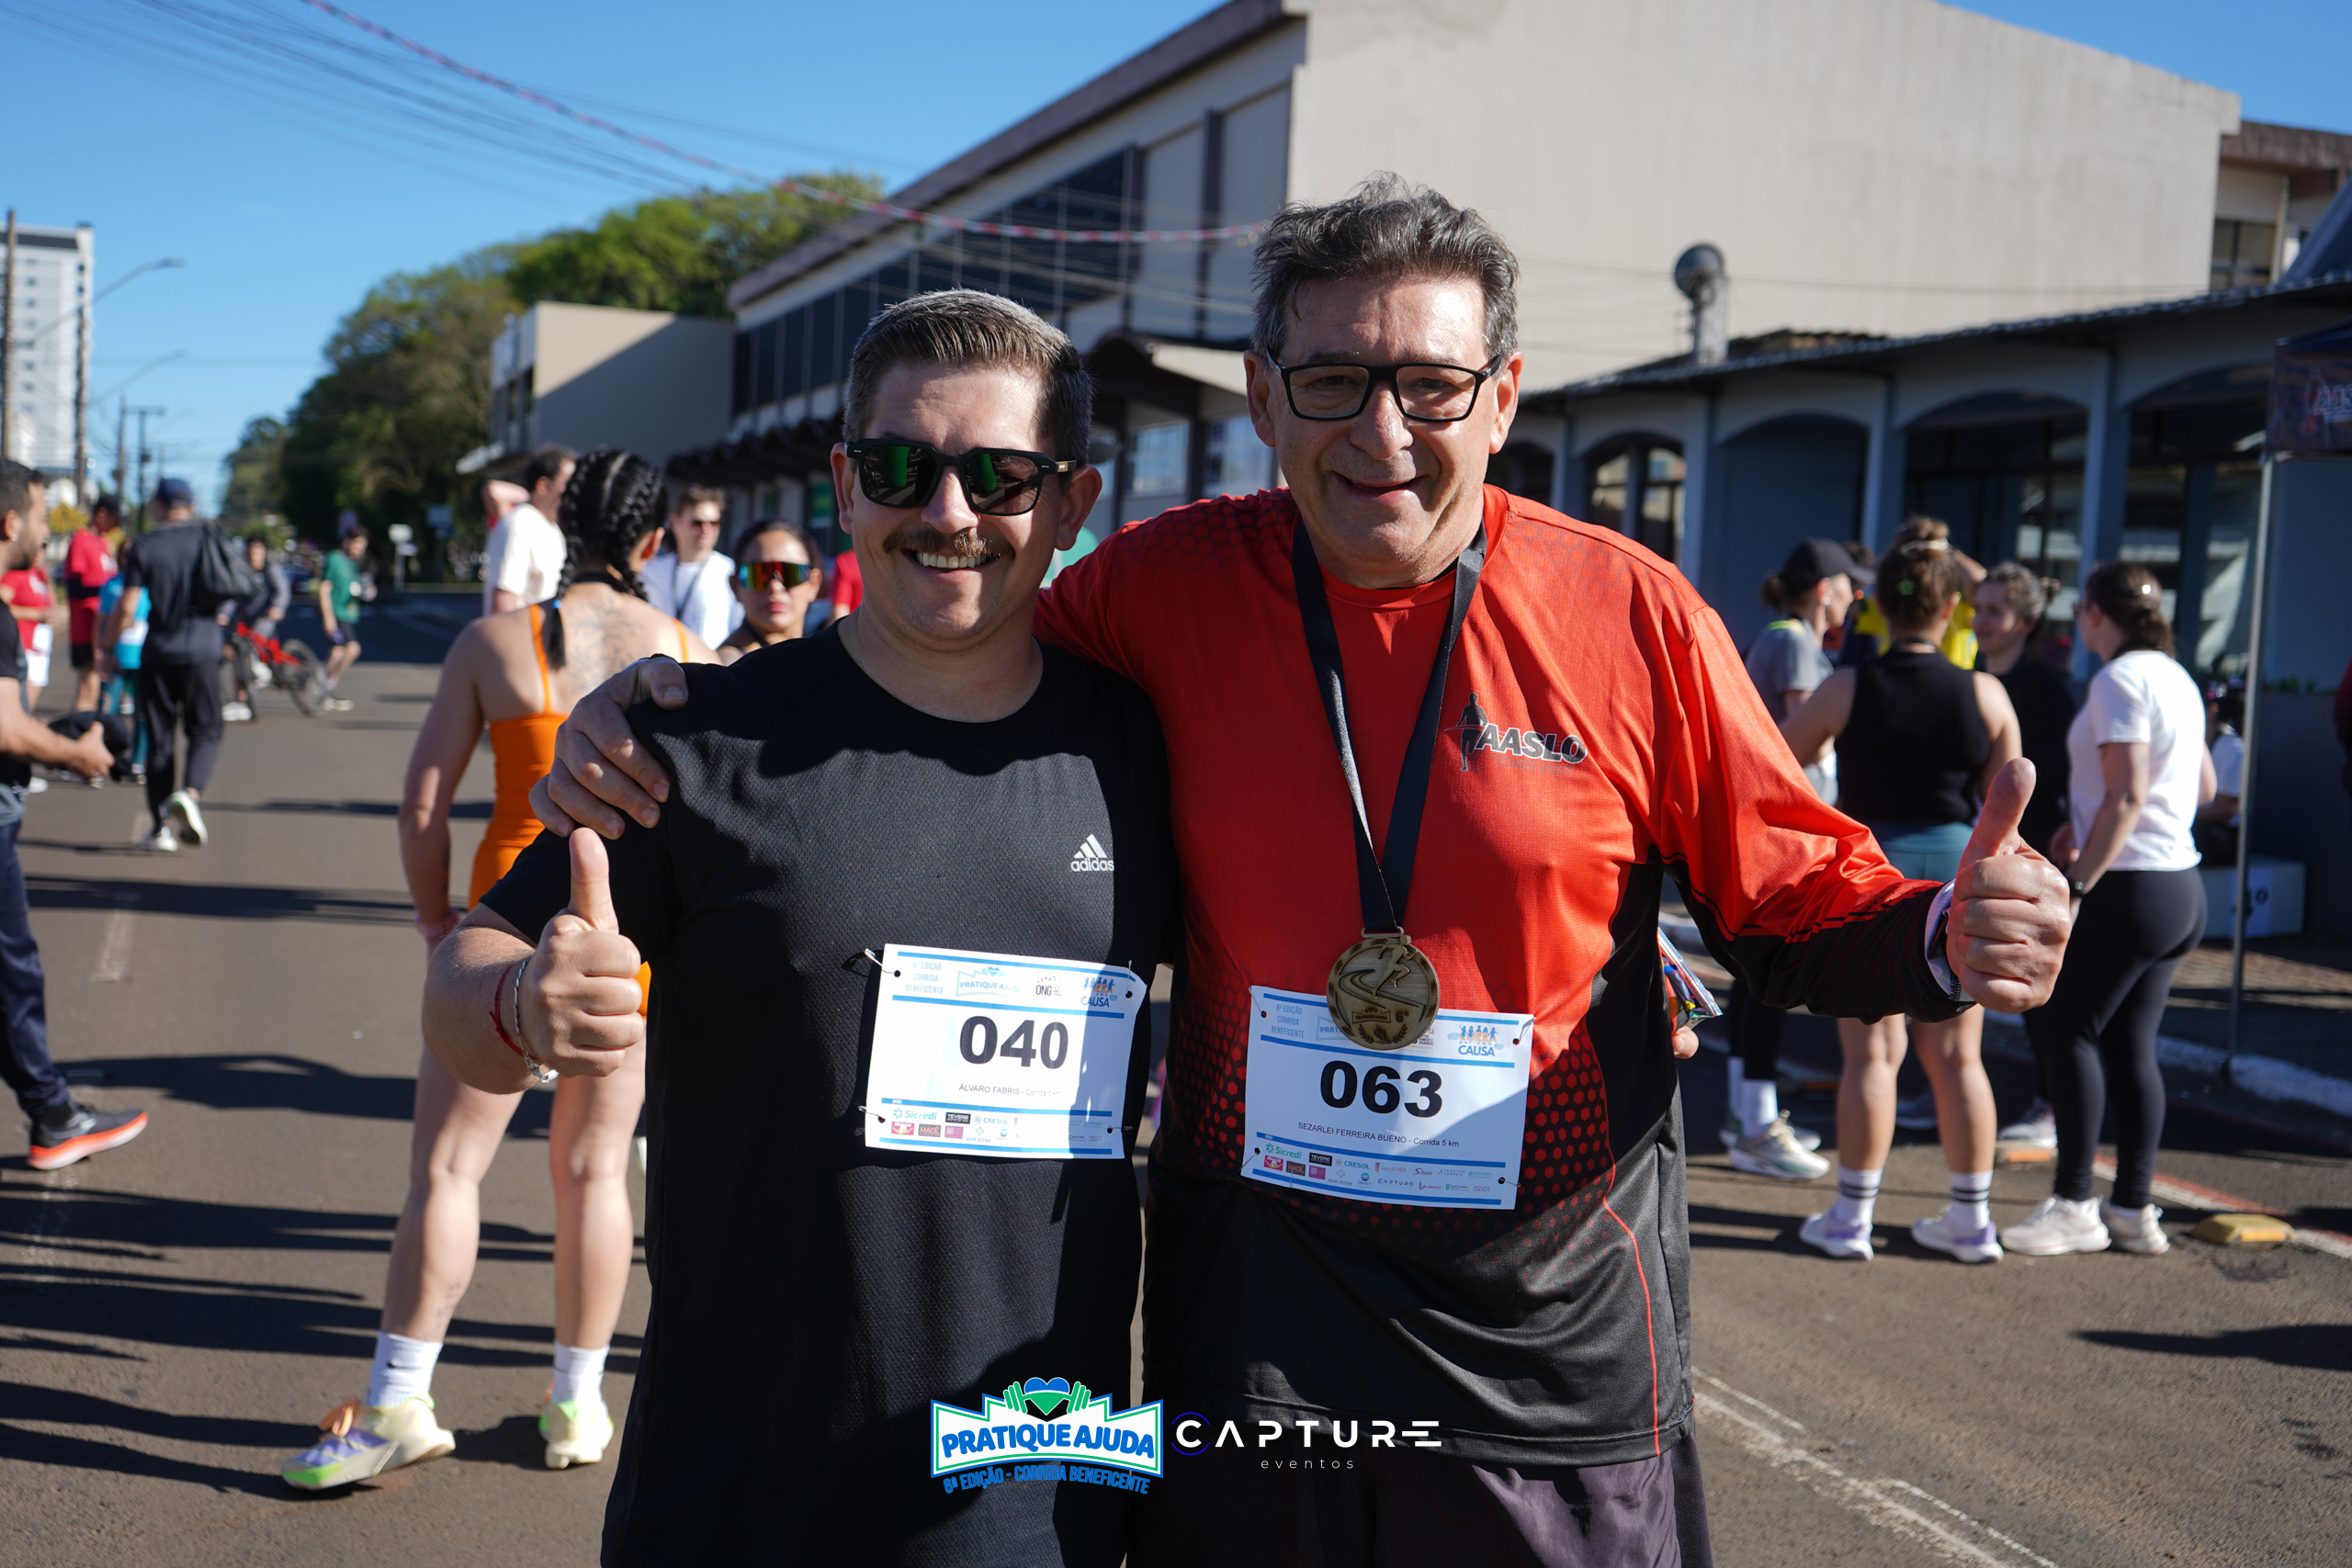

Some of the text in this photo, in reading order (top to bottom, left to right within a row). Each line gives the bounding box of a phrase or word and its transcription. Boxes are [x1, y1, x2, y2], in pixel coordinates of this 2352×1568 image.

[1474, 723, 1588, 764] AASLO
[1070, 857, 1114, 872] adidas
[921, 961, 942, 971] EDIÇÃO
[913, 972, 938, 982] CORRIDA
[905, 984, 944, 995] BENEFICENTE
[959, 981, 998, 990] PRATIQUE
[1035, 985, 1052, 997] ONG
[1080, 996, 1110, 1008] CAUSA
[1283, 1004, 1303, 1015] EDIÇÃO
[1277, 1015, 1299, 1025] CORRIDA
[1271, 1025, 1305, 1038] BENEFICENTE
[959, 1015, 1069, 1069] 040
[1459, 1032, 1498, 1043] CORRA
[1458, 1045, 1496, 1056] CAUSA
[958, 1082, 991, 1093] ÁLVARO
[992, 1086, 1020, 1096] FABRIS
[1320, 1060, 1442, 1119] 063
[905, 1110, 937, 1121] Sicredi
[983, 1117, 1008, 1125] CRESOL
[1298, 1122, 1334, 1134] SEZARLEI
[1336, 1128, 1376, 1140] FERREIRA
[1377, 1132, 1407, 1144] BUENO
[1414, 1137, 1440, 1147] Corrida
[1448, 1139, 1459, 1147] km
[1275, 1146, 1302, 1159] Sicredi
[1344, 1161, 1370, 1169] CRESOL
[1378, 1179, 1414, 1187] CAPTURE
